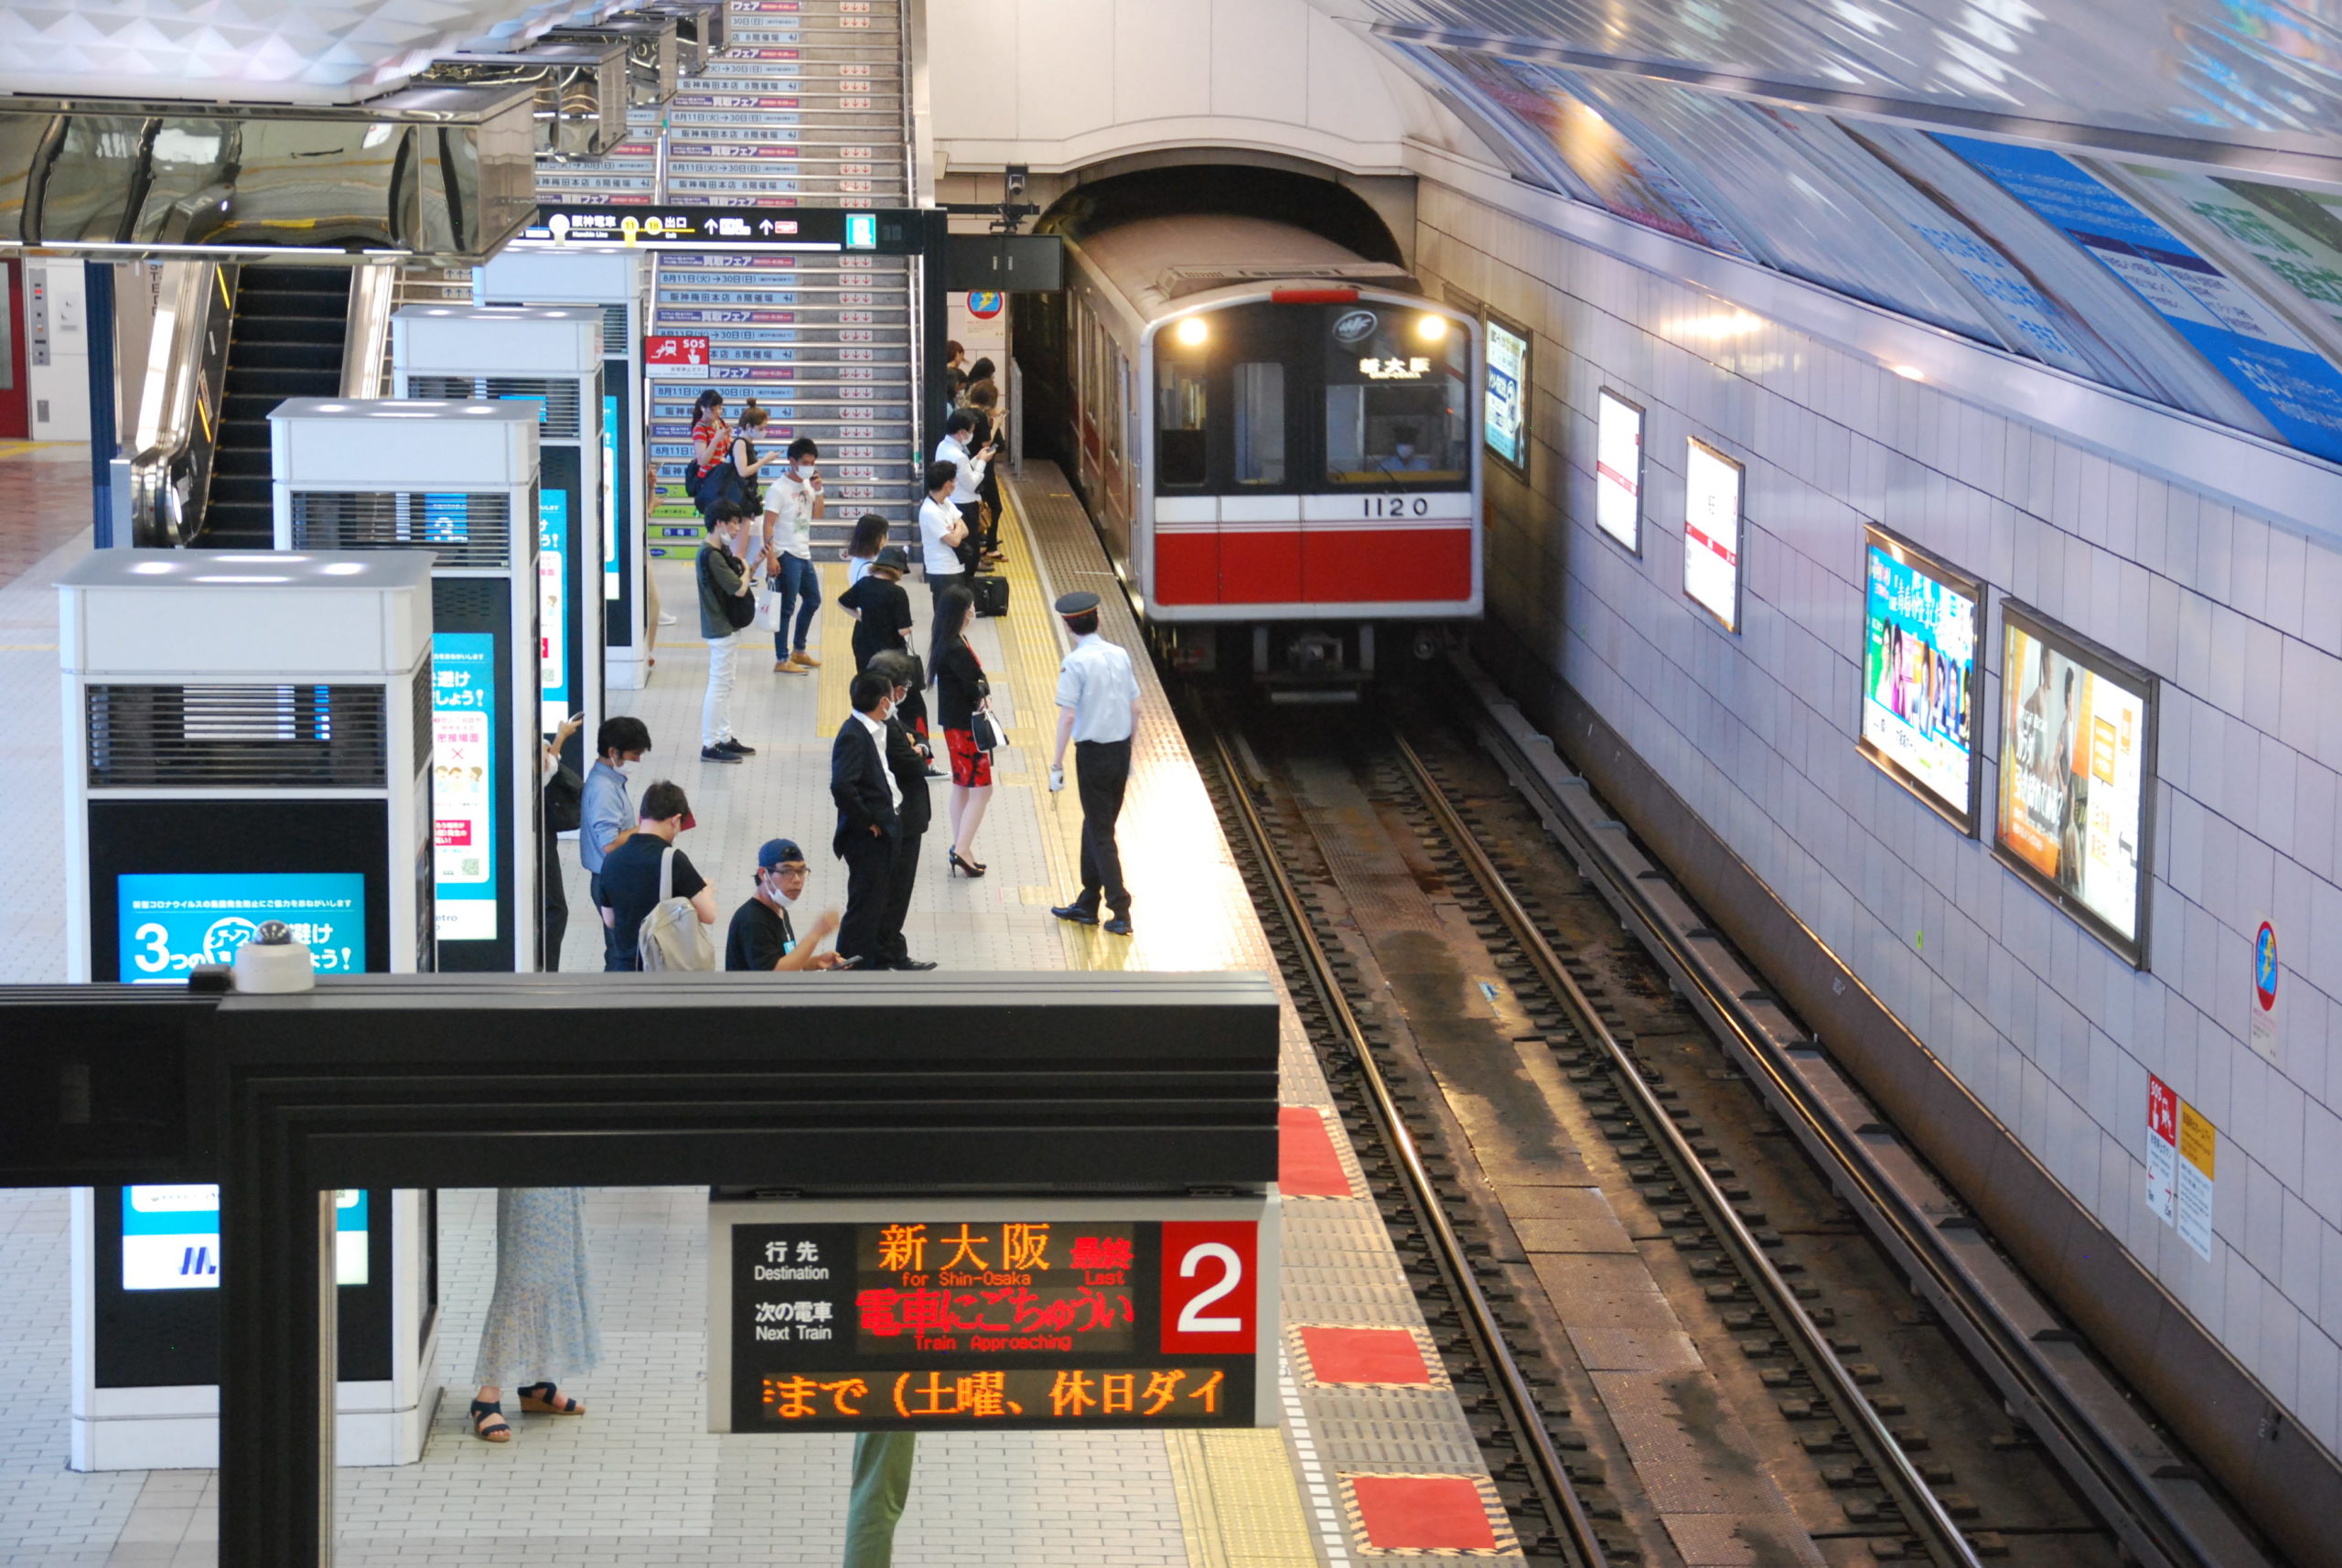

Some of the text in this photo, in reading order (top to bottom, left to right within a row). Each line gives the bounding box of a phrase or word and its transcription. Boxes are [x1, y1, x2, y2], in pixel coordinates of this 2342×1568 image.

[535, 176, 589, 187] 神梅田本店
[665, 216, 687, 229] 出口
[682, 339, 705, 349] SOS
[1364, 498, 1428, 517] 1120
[433, 689, 484, 707] しょう!
[765, 1240, 820, 1262] 行先
[879, 1224, 1134, 1272] 新大阪 最終
[754, 1265, 830, 1281] Destination
[902, 1270, 1125, 1286] for Shin-Osaka Last
[1177, 1242, 1243, 1333] 2
[755, 1301, 833, 1323] 次の電車
[855, 1287, 1135, 1337] 電車にごちゅうい
[756, 1325, 833, 1341] Next Train
[915, 1335, 1073, 1352] Train Approaching
